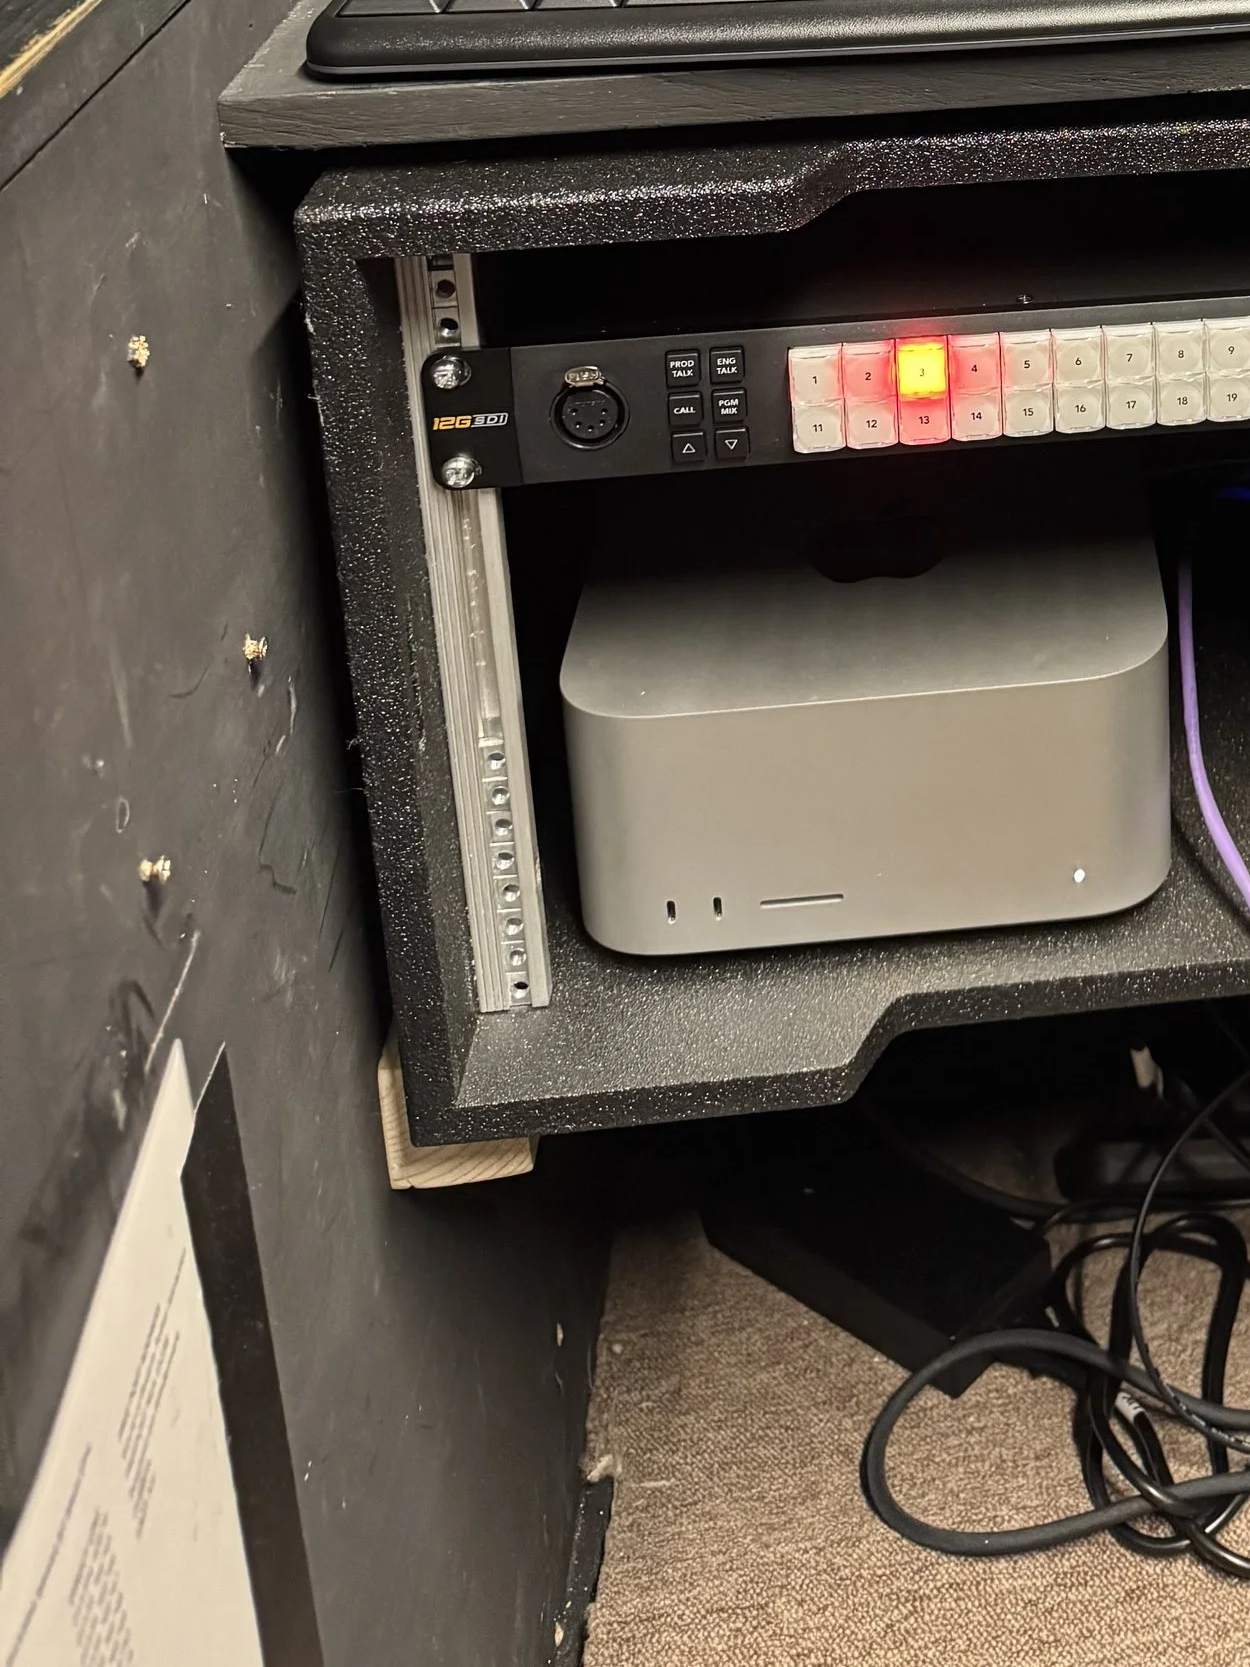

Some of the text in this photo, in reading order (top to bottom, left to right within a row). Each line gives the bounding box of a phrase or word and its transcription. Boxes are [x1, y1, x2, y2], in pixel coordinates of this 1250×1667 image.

[670, 359, 695, 369] PROD
[716, 357, 736, 367] ENG
[672, 368, 693, 377] TALK
[716, 365, 738, 375] TALK
[1176, 396, 1188, 406] 18
[1226, 392, 1238, 402] 19
[718, 398, 739, 408] PGM
[1126, 400, 1137, 410] 17
[673, 405, 696, 415] CALL
[720, 406, 738, 416] MIX
[1022, 407, 1034, 418] 15
[1074, 403, 1086, 414] 16
[918, 415, 930, 426] 13
[970, 411, 982, 422] 14
[432, 414, 472, 430] 12G
[866, 419, 878, 429] 12
[812, 424, 823, 433] 11
